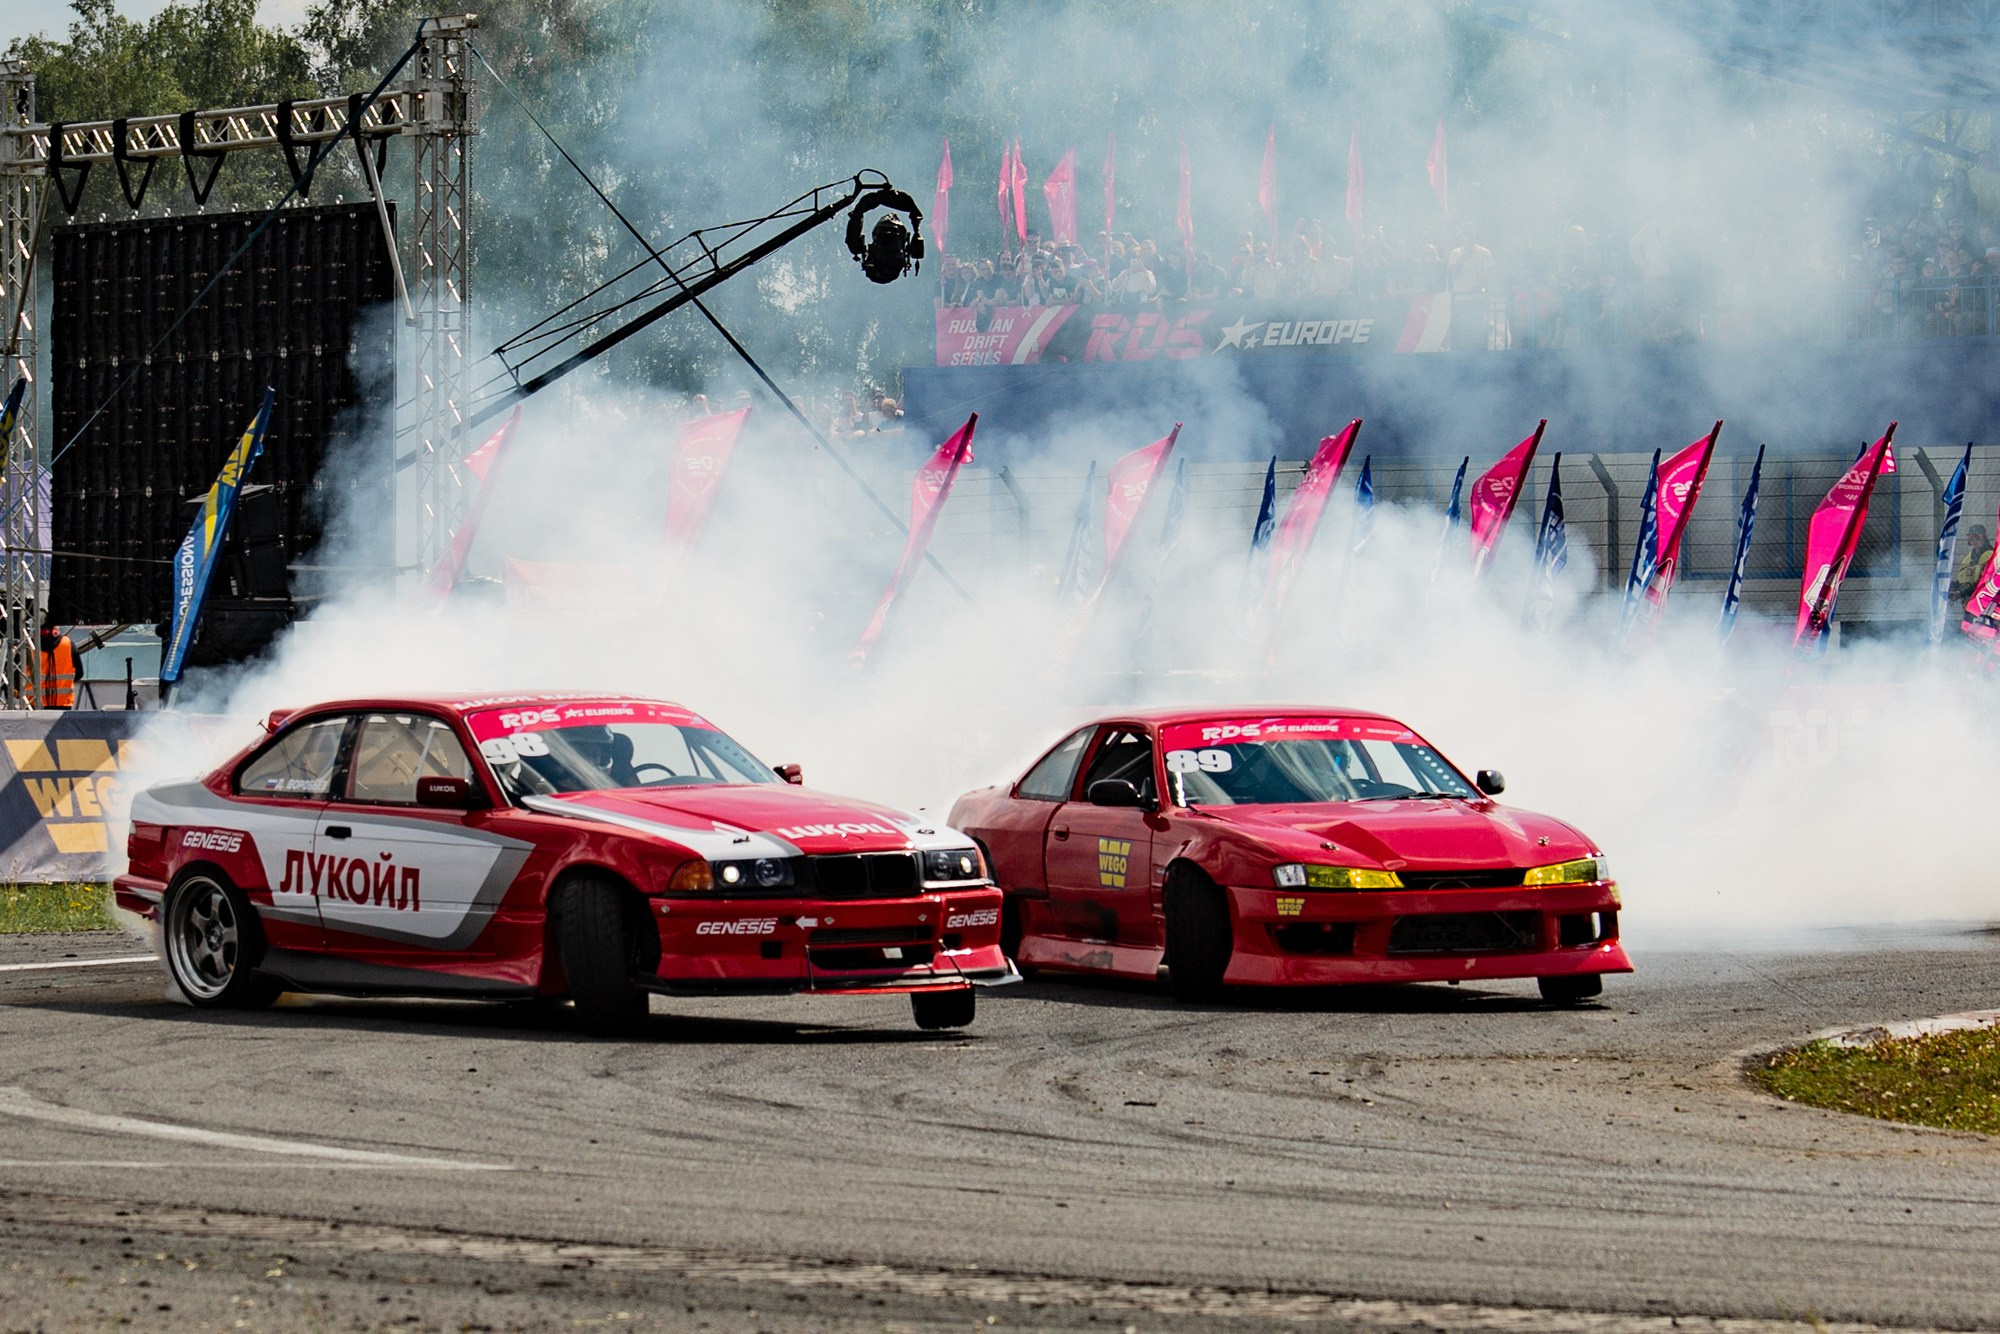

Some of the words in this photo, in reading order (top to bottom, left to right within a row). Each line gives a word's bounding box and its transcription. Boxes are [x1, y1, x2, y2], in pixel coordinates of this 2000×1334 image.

[948, 319, 1014, 333] RUSIAN
[963, 335, 1008, 350] DRIFT
[1084, 311, 1213, 363] RDS
[1262, 318, 1375, 346] EUROPE
[452, 695, 538, 710] LUKOIL
[499, 708, 561, 729] RDS
[585, 708, 635, 716] EUROPE
[1202, 723, 1261, 740] RDS
[1288, 724, 1339, 732] EUROPE
[480, 732, 550, 765] 98
[1165, 750, 1233, 773] 89
[22, 775, 131, 818] WEG
[776, 822, 896, 839] LUKOIL
[182, 830, 242, 853] GENESIS
[1099, 853, 1127, 874] WEGO
[279, 849, 420, 912] ЛУКОЙЛ
[695, 921, 777, 935] GENESIS
[947, 911, 998, 929] GENESIS
